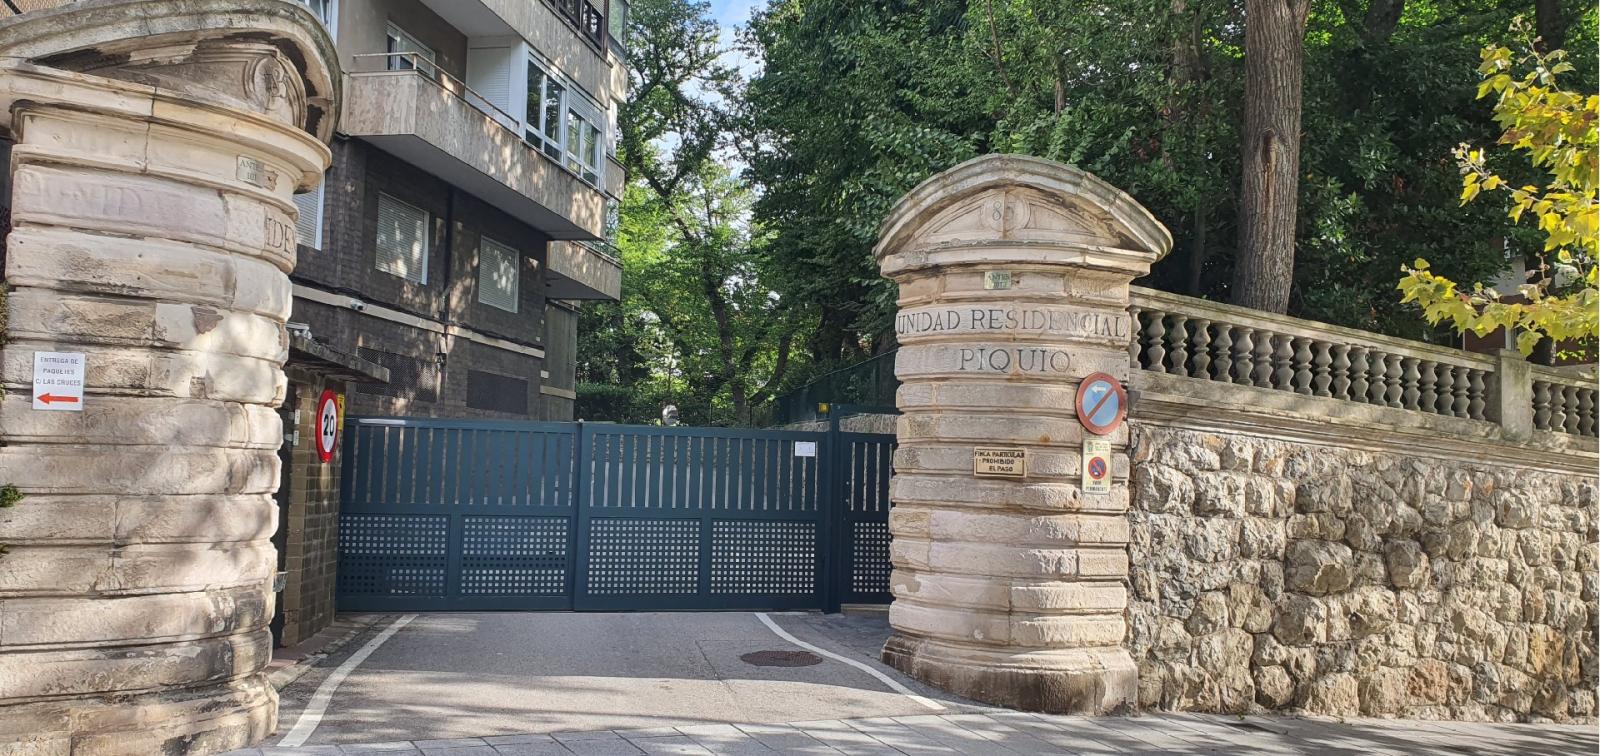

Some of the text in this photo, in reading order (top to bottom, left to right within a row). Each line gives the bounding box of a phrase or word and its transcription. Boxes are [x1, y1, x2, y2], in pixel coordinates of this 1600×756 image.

[898, 309, 1126, 338] UNIDAD RESIDENCIAL
[40, 356, 69, 364] ENTREGA
[958, 348, 1071, 373] PIQUIO
[323, 414, 335, 437] 20
